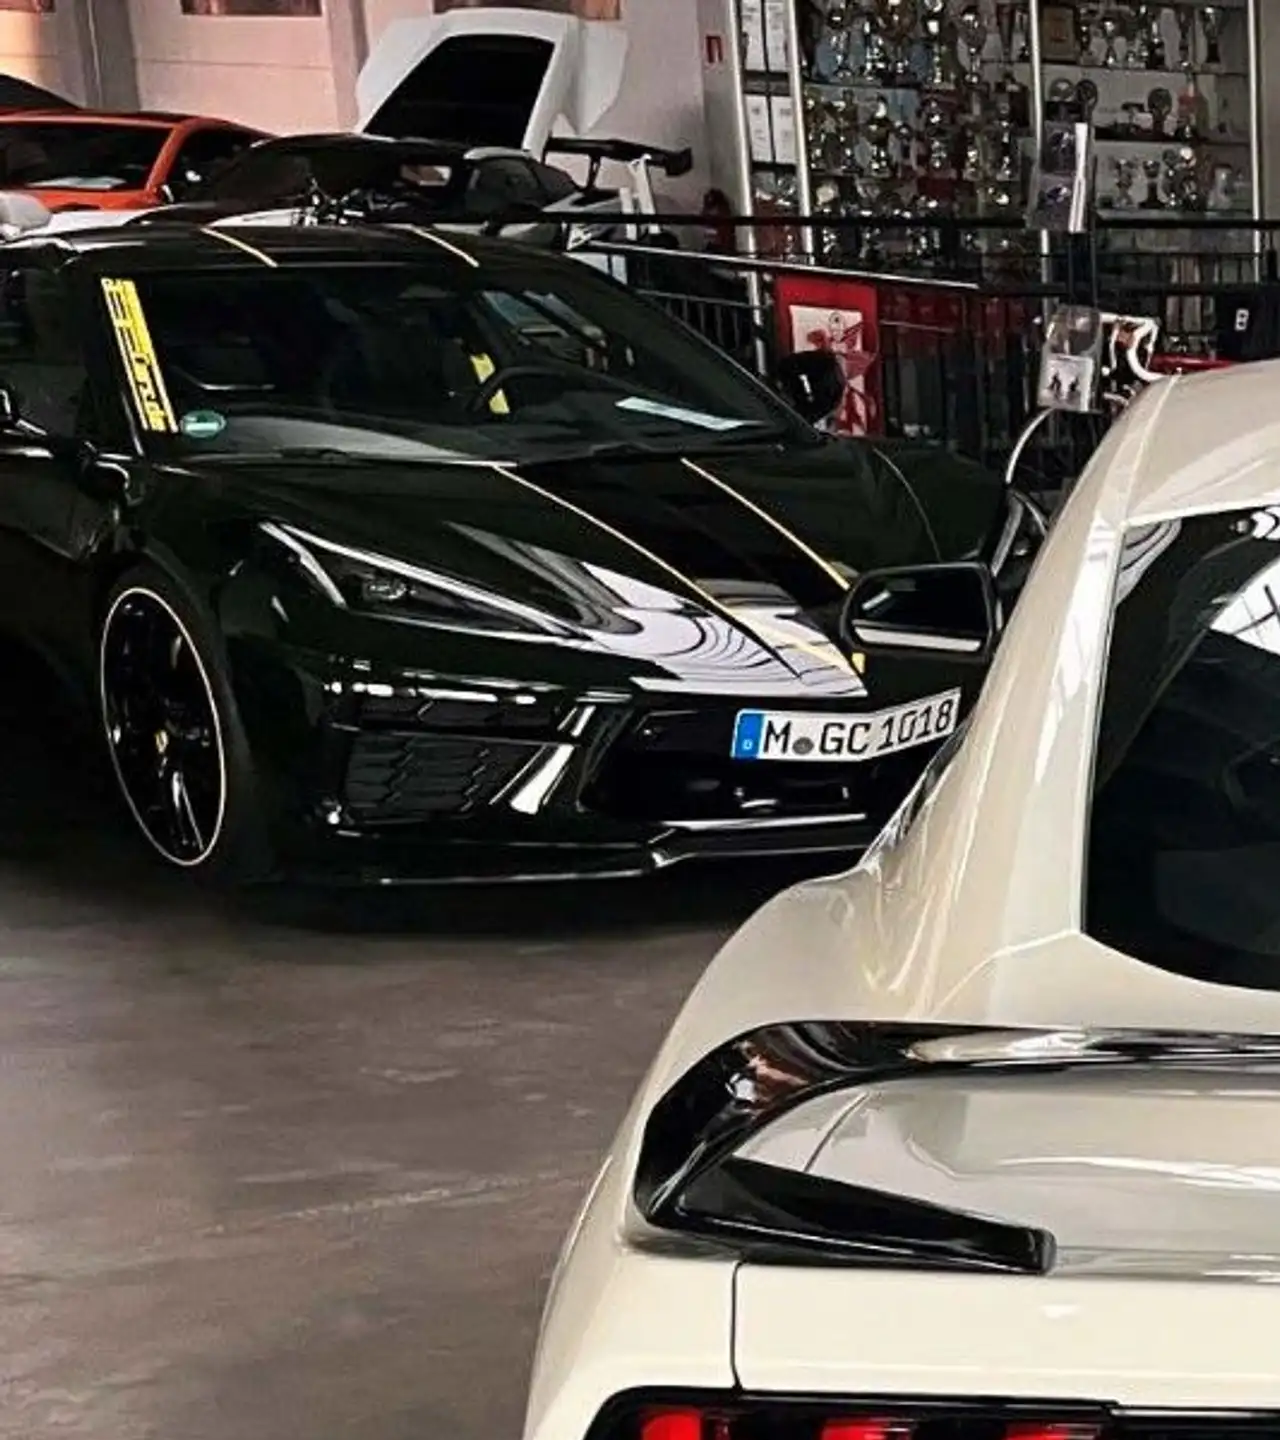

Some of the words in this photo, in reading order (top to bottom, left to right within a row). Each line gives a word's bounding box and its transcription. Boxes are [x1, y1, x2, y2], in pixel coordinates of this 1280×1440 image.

[763, 720, 791, 753] M
[819, 722, 872, 755] GC
[876, 699, 953, 750] 1018
